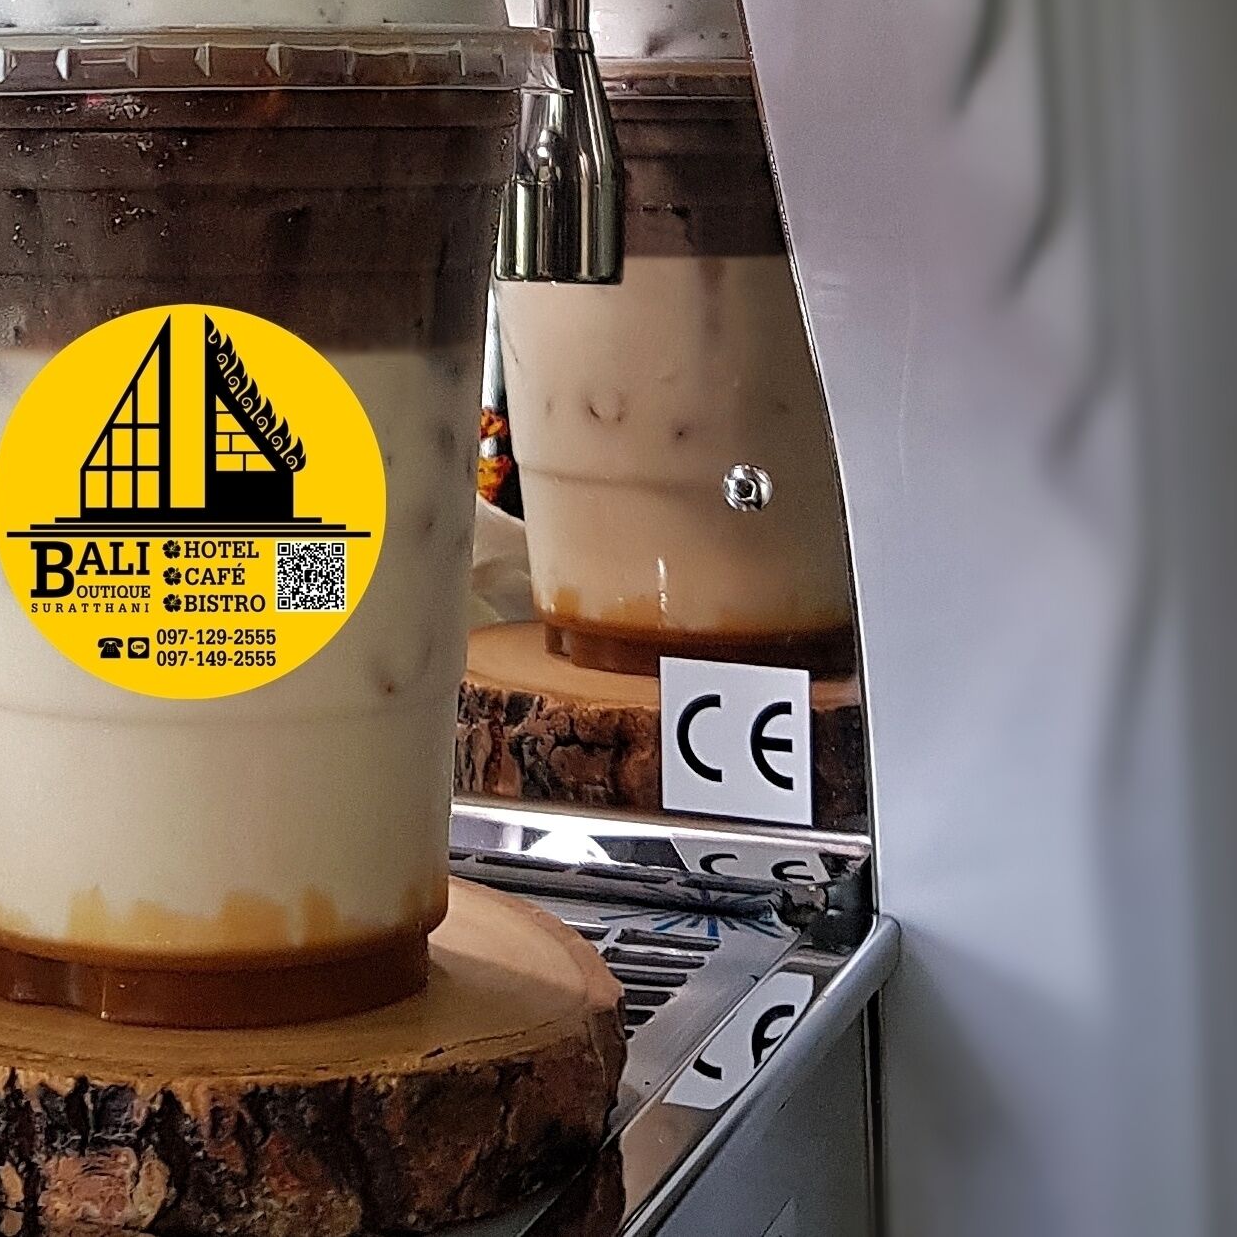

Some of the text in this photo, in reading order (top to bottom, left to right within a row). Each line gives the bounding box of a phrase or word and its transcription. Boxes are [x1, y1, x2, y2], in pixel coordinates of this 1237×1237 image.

[183, 541, 260, 559] HOTEL
[184, 563, 246, 586] CAFÉ
[31, 603, 150, 613] SURATTHANI
[183, 594, 266, 613] BISTRO
[156, 629, 276, 646] 097-129-2555
[156, 650, 276, 667] 097-149-2555
[676, 693, 794, 791] CE
